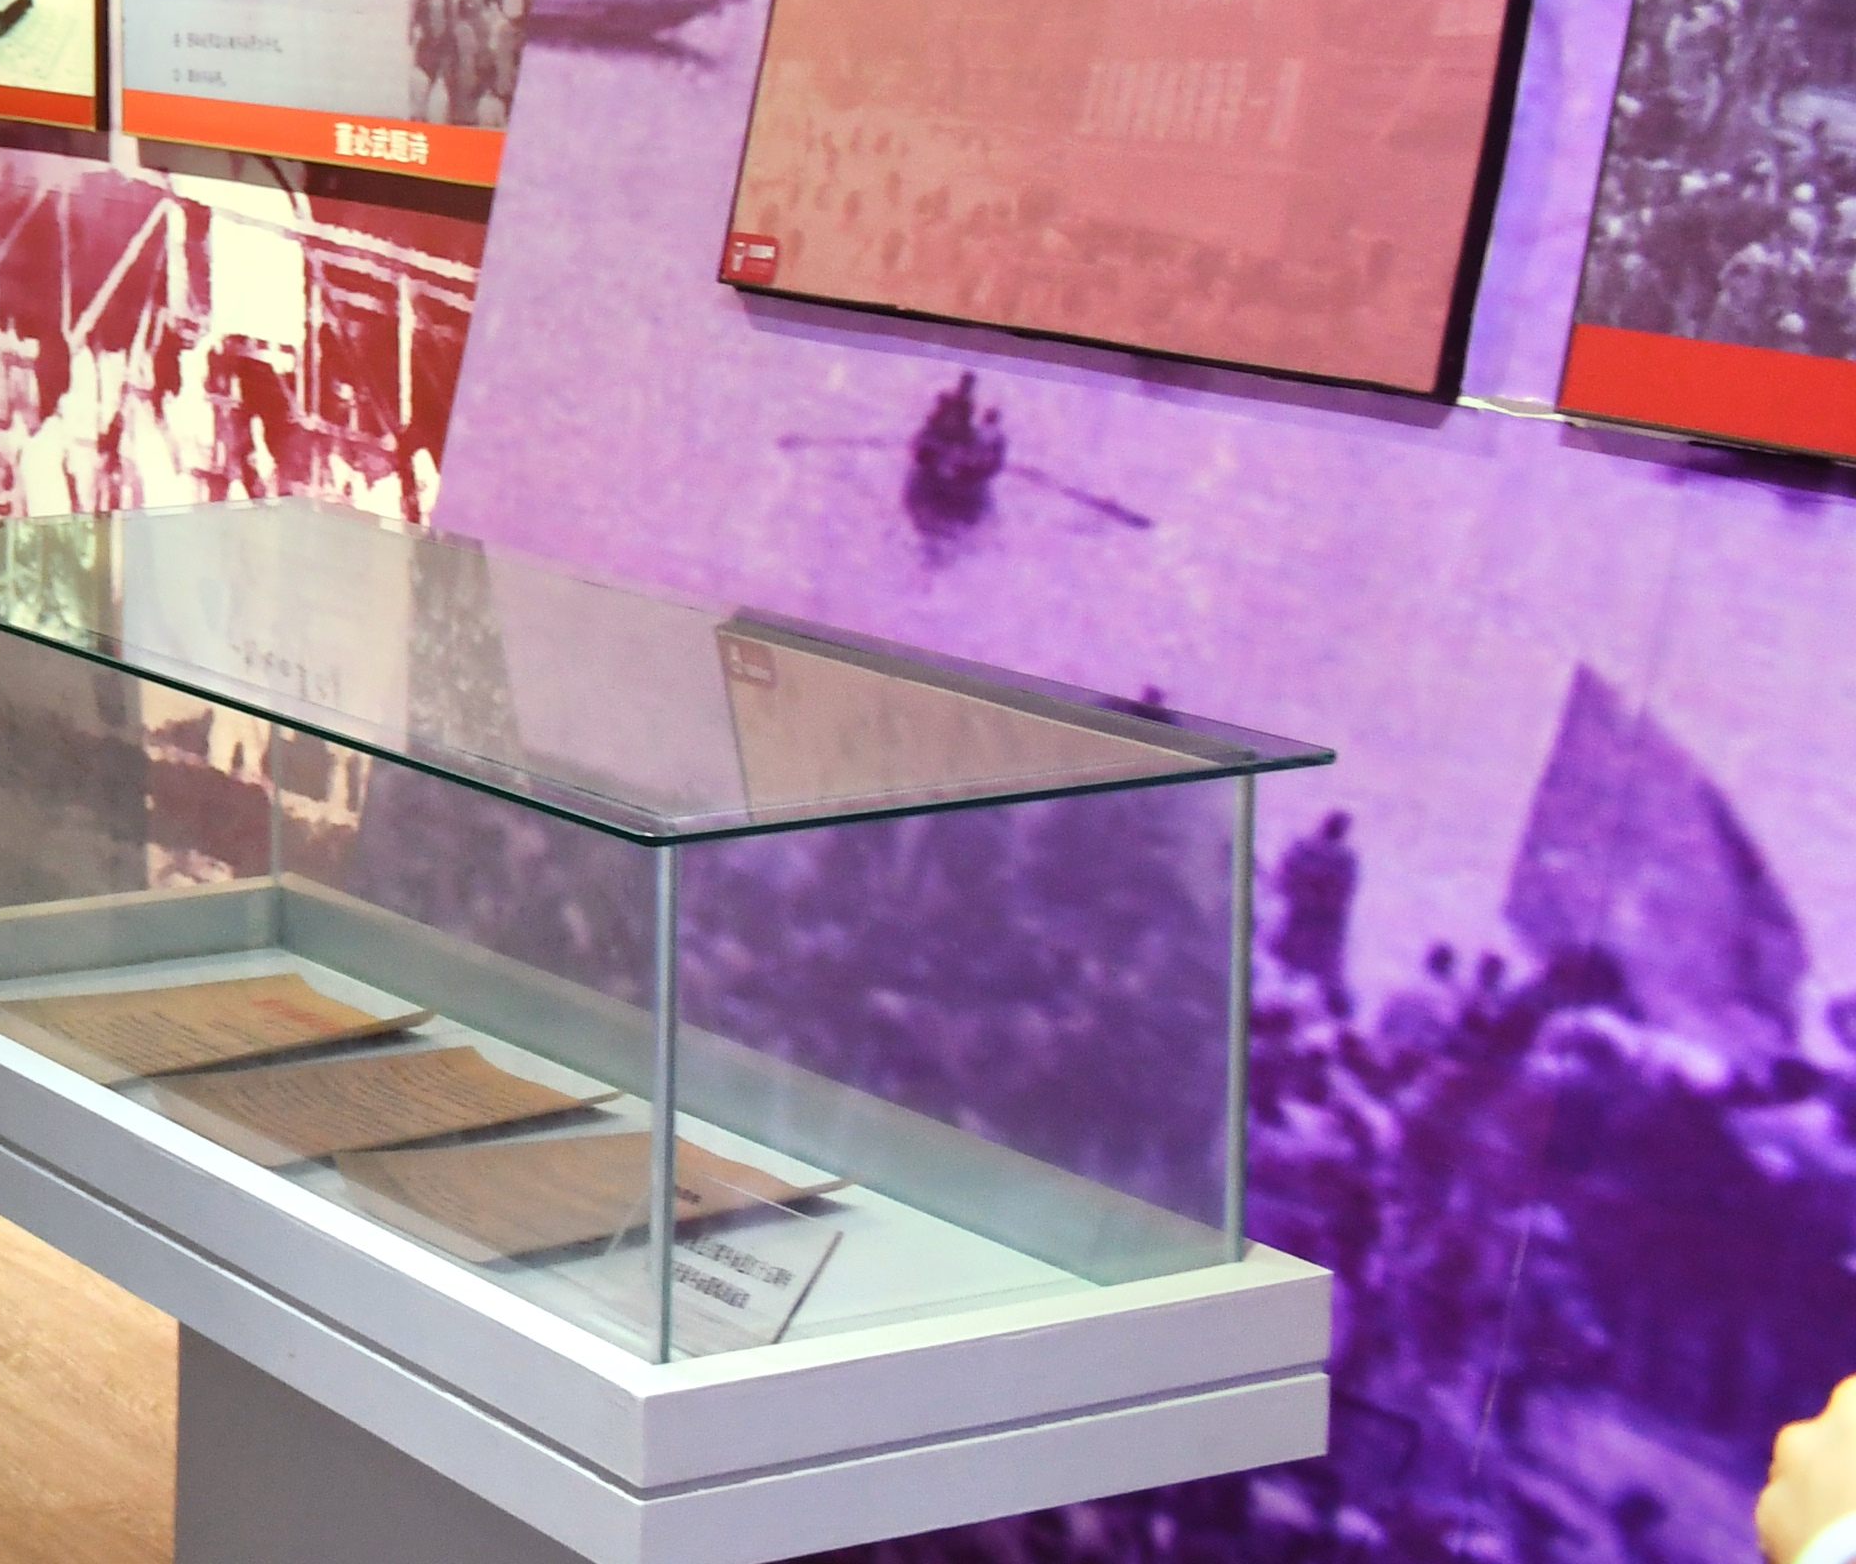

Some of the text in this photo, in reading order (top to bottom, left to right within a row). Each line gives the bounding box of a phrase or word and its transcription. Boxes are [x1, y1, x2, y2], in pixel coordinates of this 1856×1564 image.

[334, 121, 430, 165] 董必武题诗
